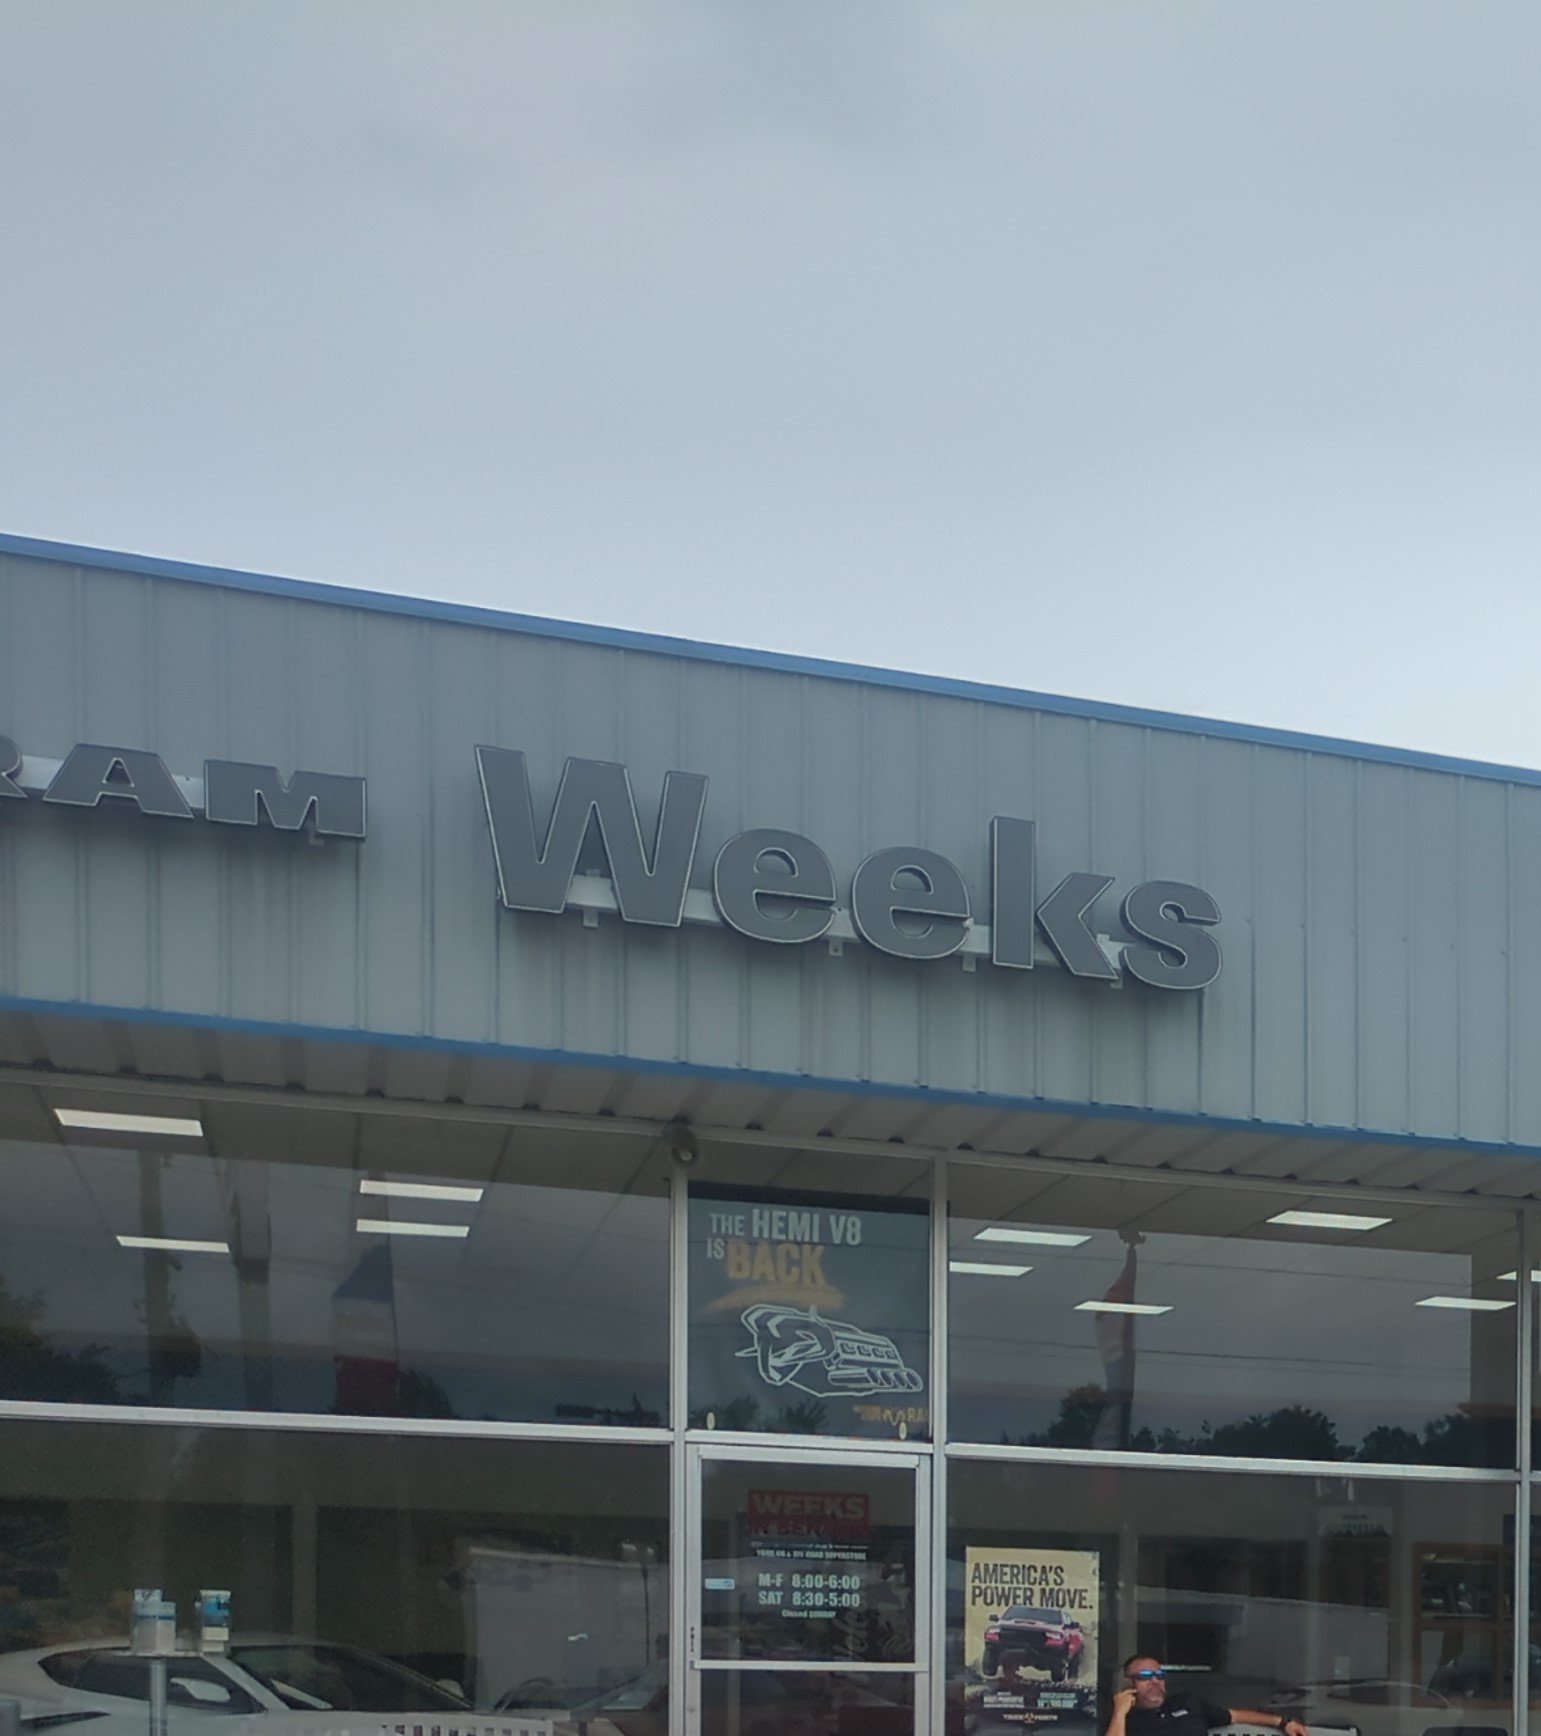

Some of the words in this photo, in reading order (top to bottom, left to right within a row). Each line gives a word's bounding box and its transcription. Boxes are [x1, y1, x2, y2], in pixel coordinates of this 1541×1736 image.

[0, 735, 367, 840] AM
[475, 744, 1223, 990] Weeks
[709, 1212, 744, 1237] THE
[752, 1208, 820, 1243] HEMI
[828, 1214, 862, 1246] V8
[706, 1238, 725, 1260] IS
[727, 1238, 827, 1287] BACK
[752, 1492, 866, 1520] WEEKS
[758, 1573, 784, 1587] M-F
[791, 1573, 861, 1590] 8:00-6:00
[971, 1562, 1065, 1587] AMERICA'S
[758, 1591, 783, 1606] SAT
[792, 1591, 861, 1607] 8:30-5:00
[971, 1585, 1035, 1607] POWER
[1040, 1587, 1094, 1610] MOVE.
